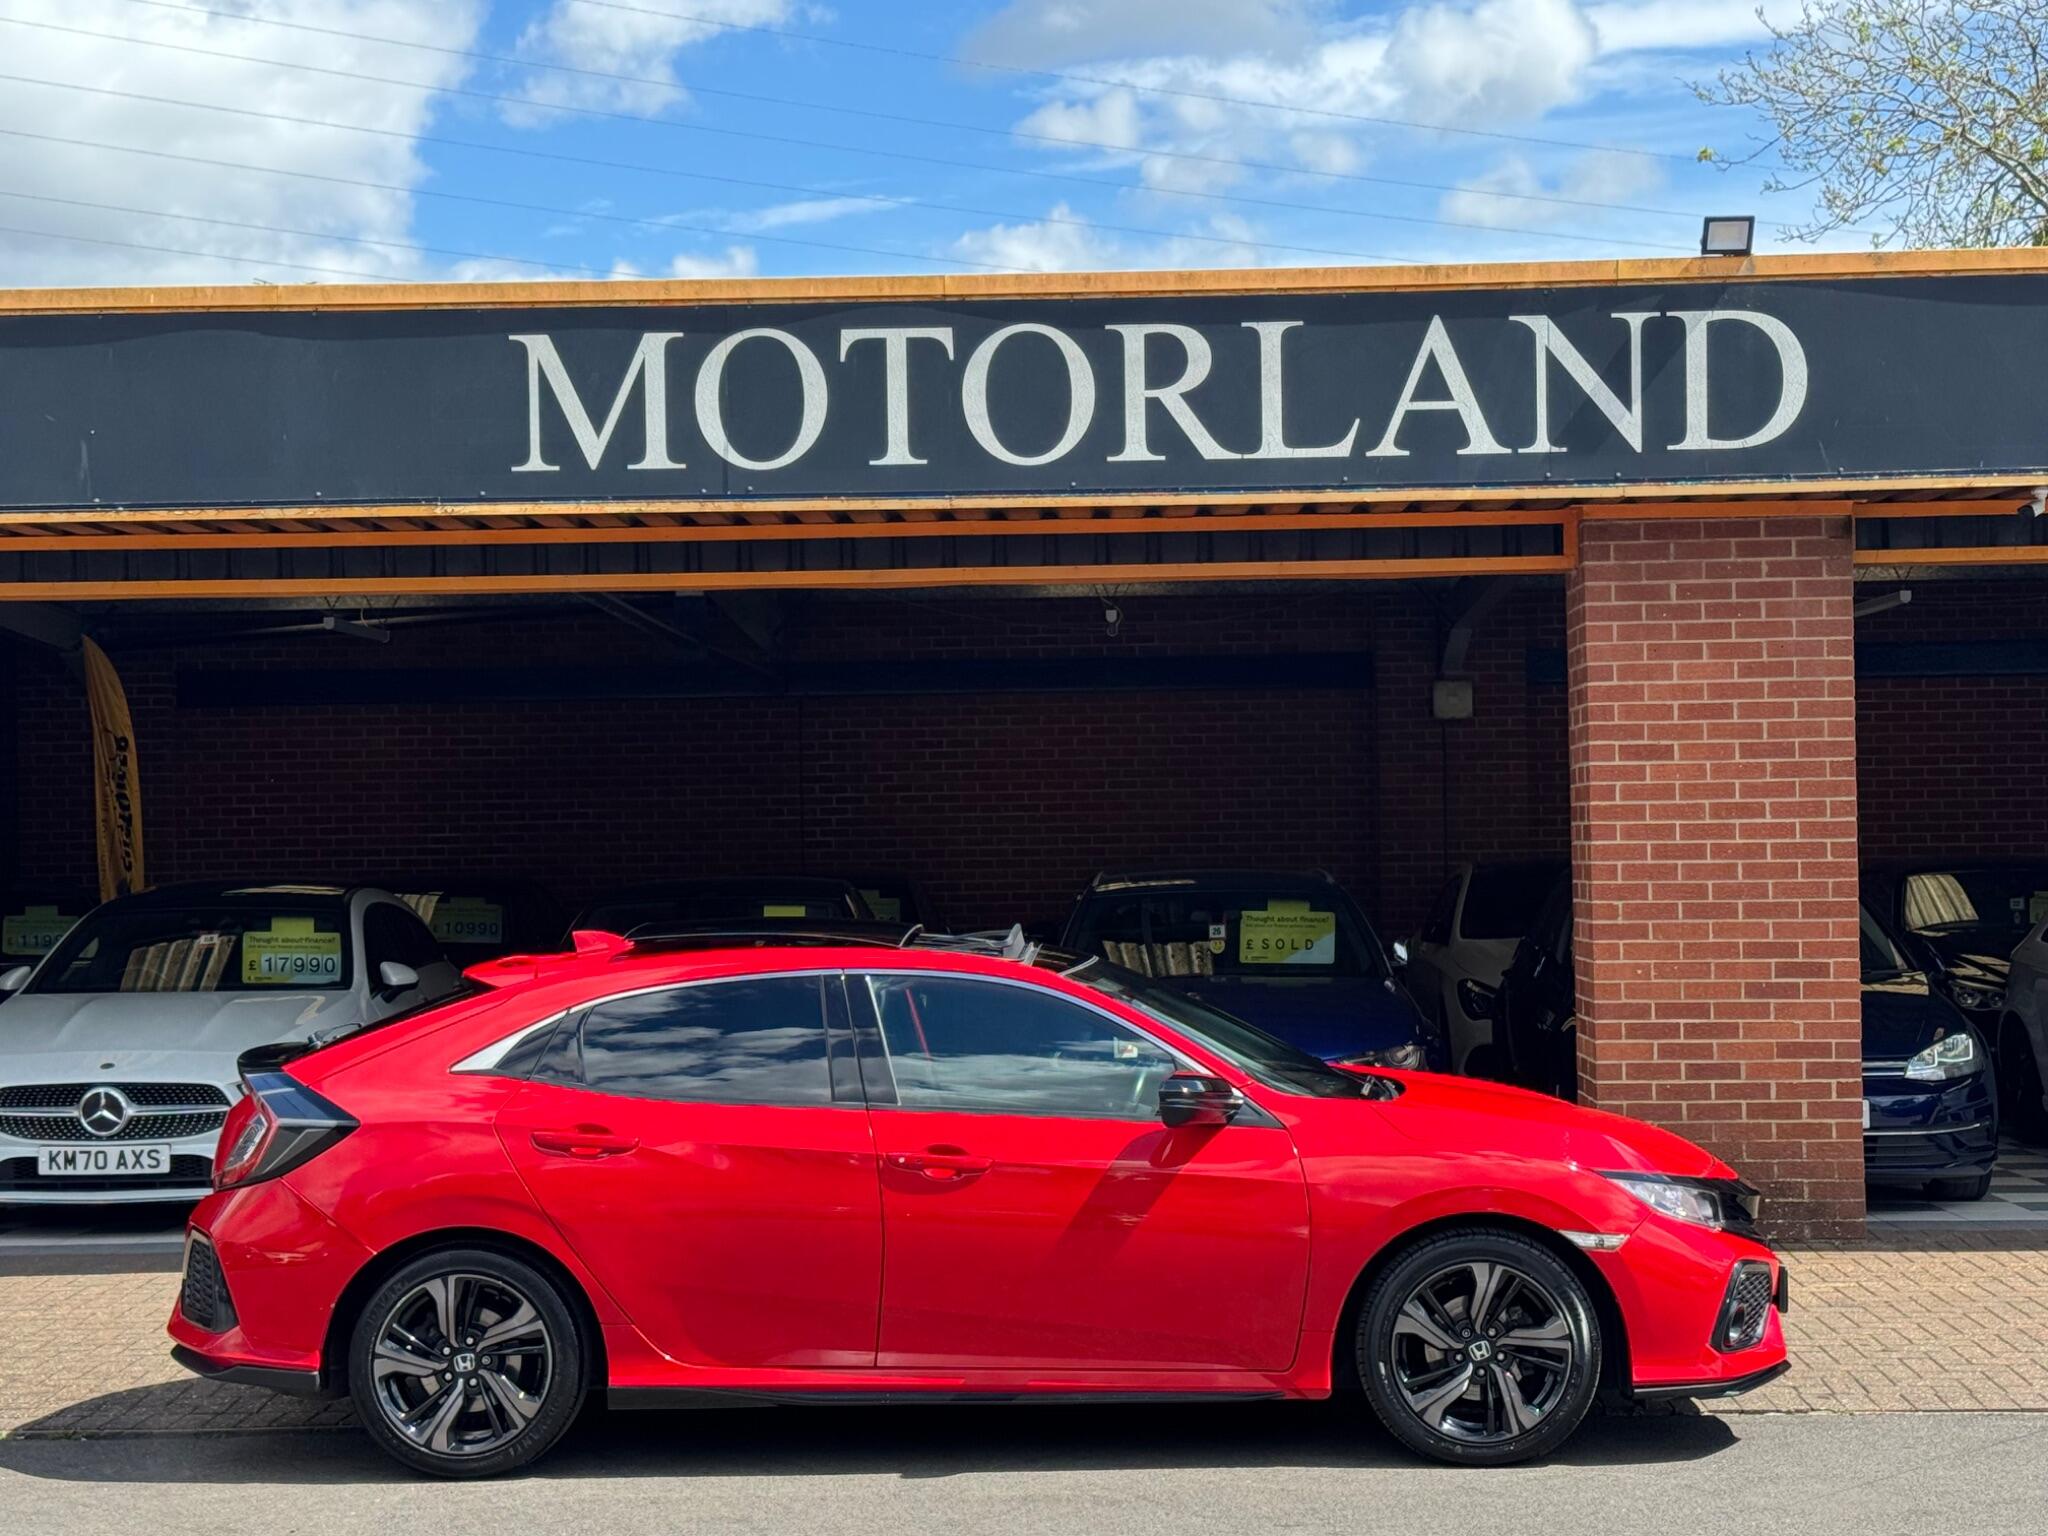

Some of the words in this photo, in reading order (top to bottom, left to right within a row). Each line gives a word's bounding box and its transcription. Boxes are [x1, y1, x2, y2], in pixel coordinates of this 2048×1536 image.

[509, 309, 1809, 474] MOTORLAND
[1246, 915, 1275, 923] Thought
[249, 936, 280, 945] Thought
[1261, 938, 1314, 950] SOLD
[264, 957, 336, 973] 17990
[48, 1150, 108, 1171] KM70
[115, 1149, 161, 1170] AXS
